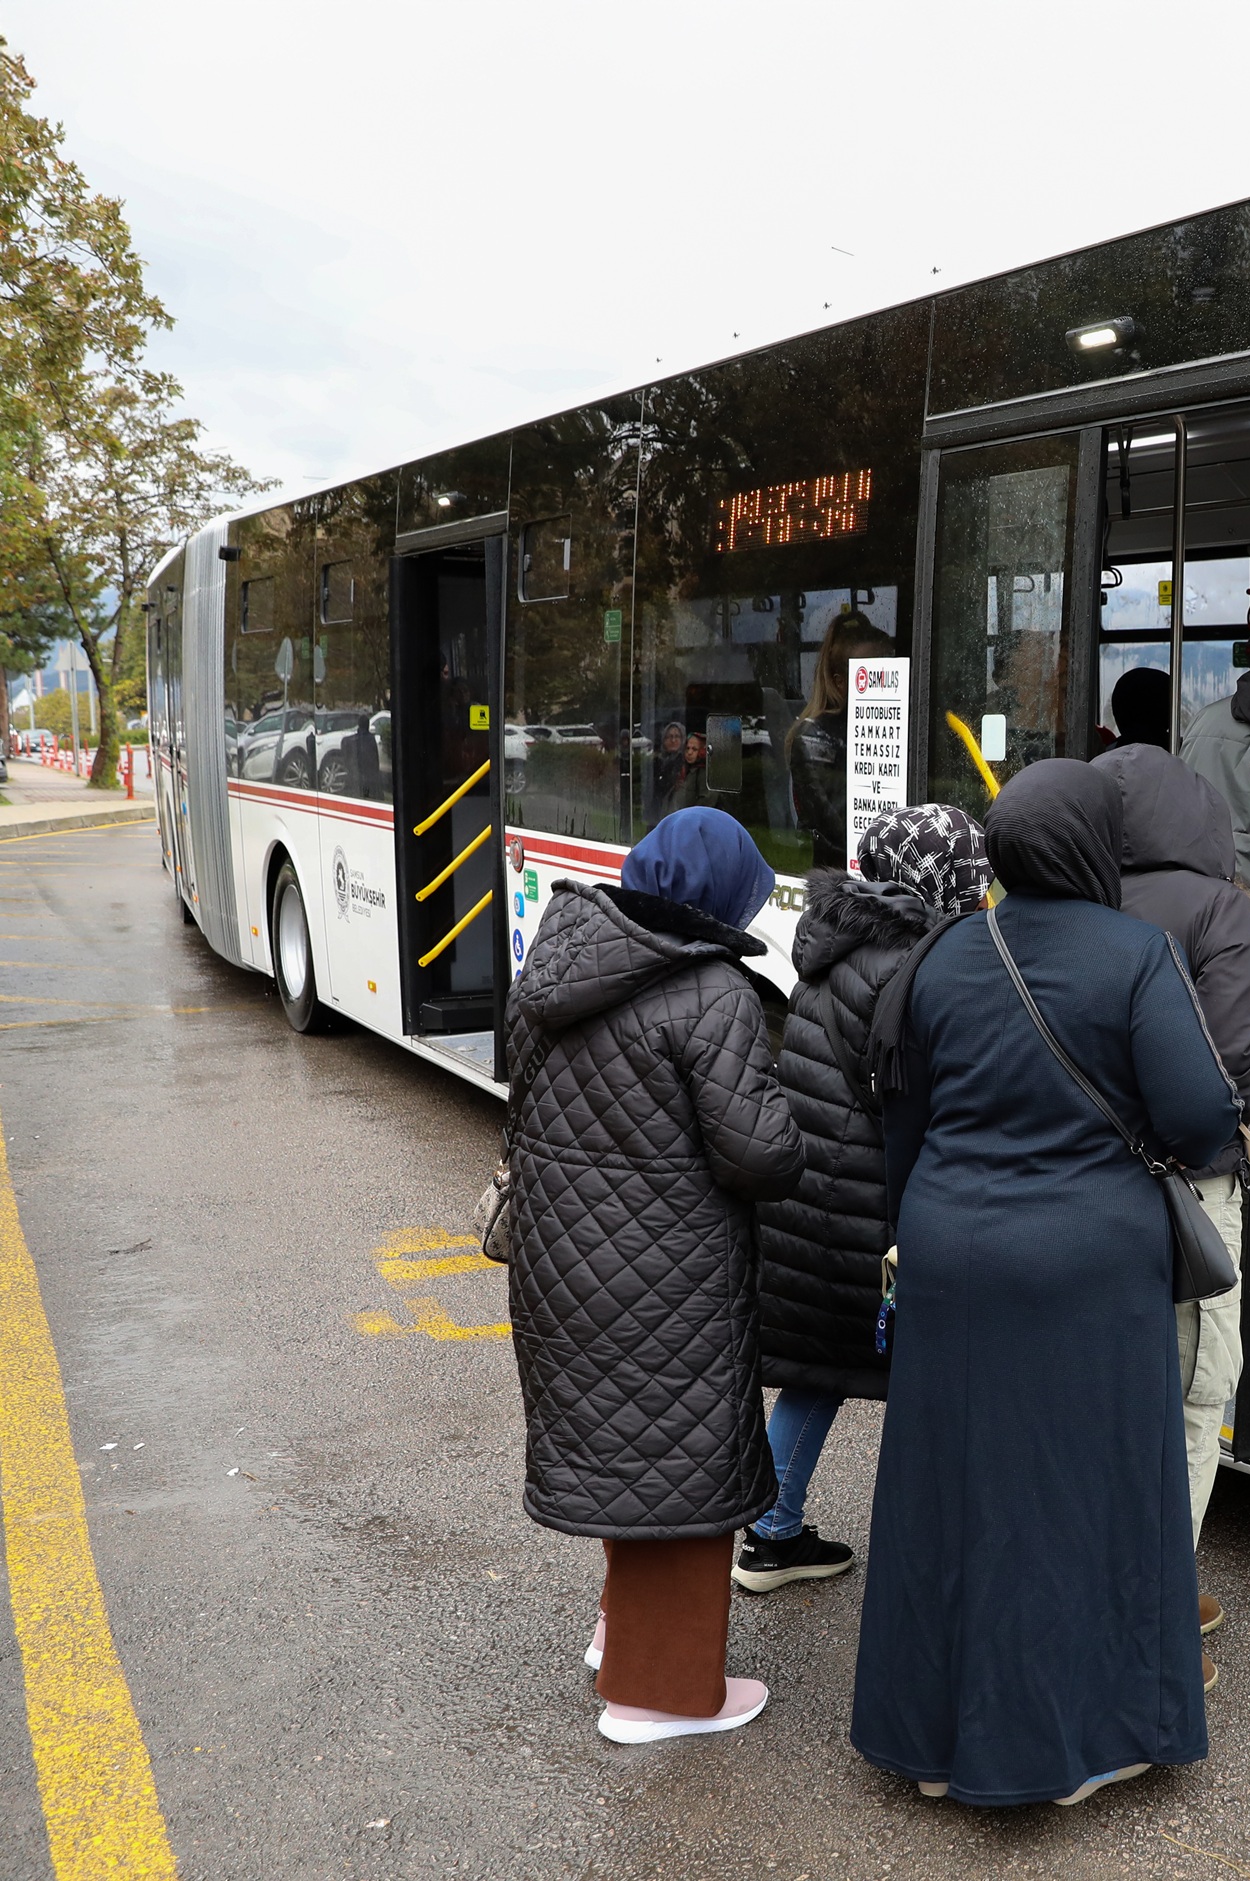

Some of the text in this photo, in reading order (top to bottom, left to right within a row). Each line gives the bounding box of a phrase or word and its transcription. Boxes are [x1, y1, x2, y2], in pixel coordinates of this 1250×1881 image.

[855, 706, 901, 721] BU OTOBÜSTE
[855, 725, 901, 741] SAMKART
[855, 743, 900, 759] TEMASSIZ
[854, 761, 900, 778] KREDİ KARTI
[871, 780, 882, 795] VE
[853, 797, 877, 813] BANKA
[350, 881, 387, 909] BÜYÜKŞEHİR
